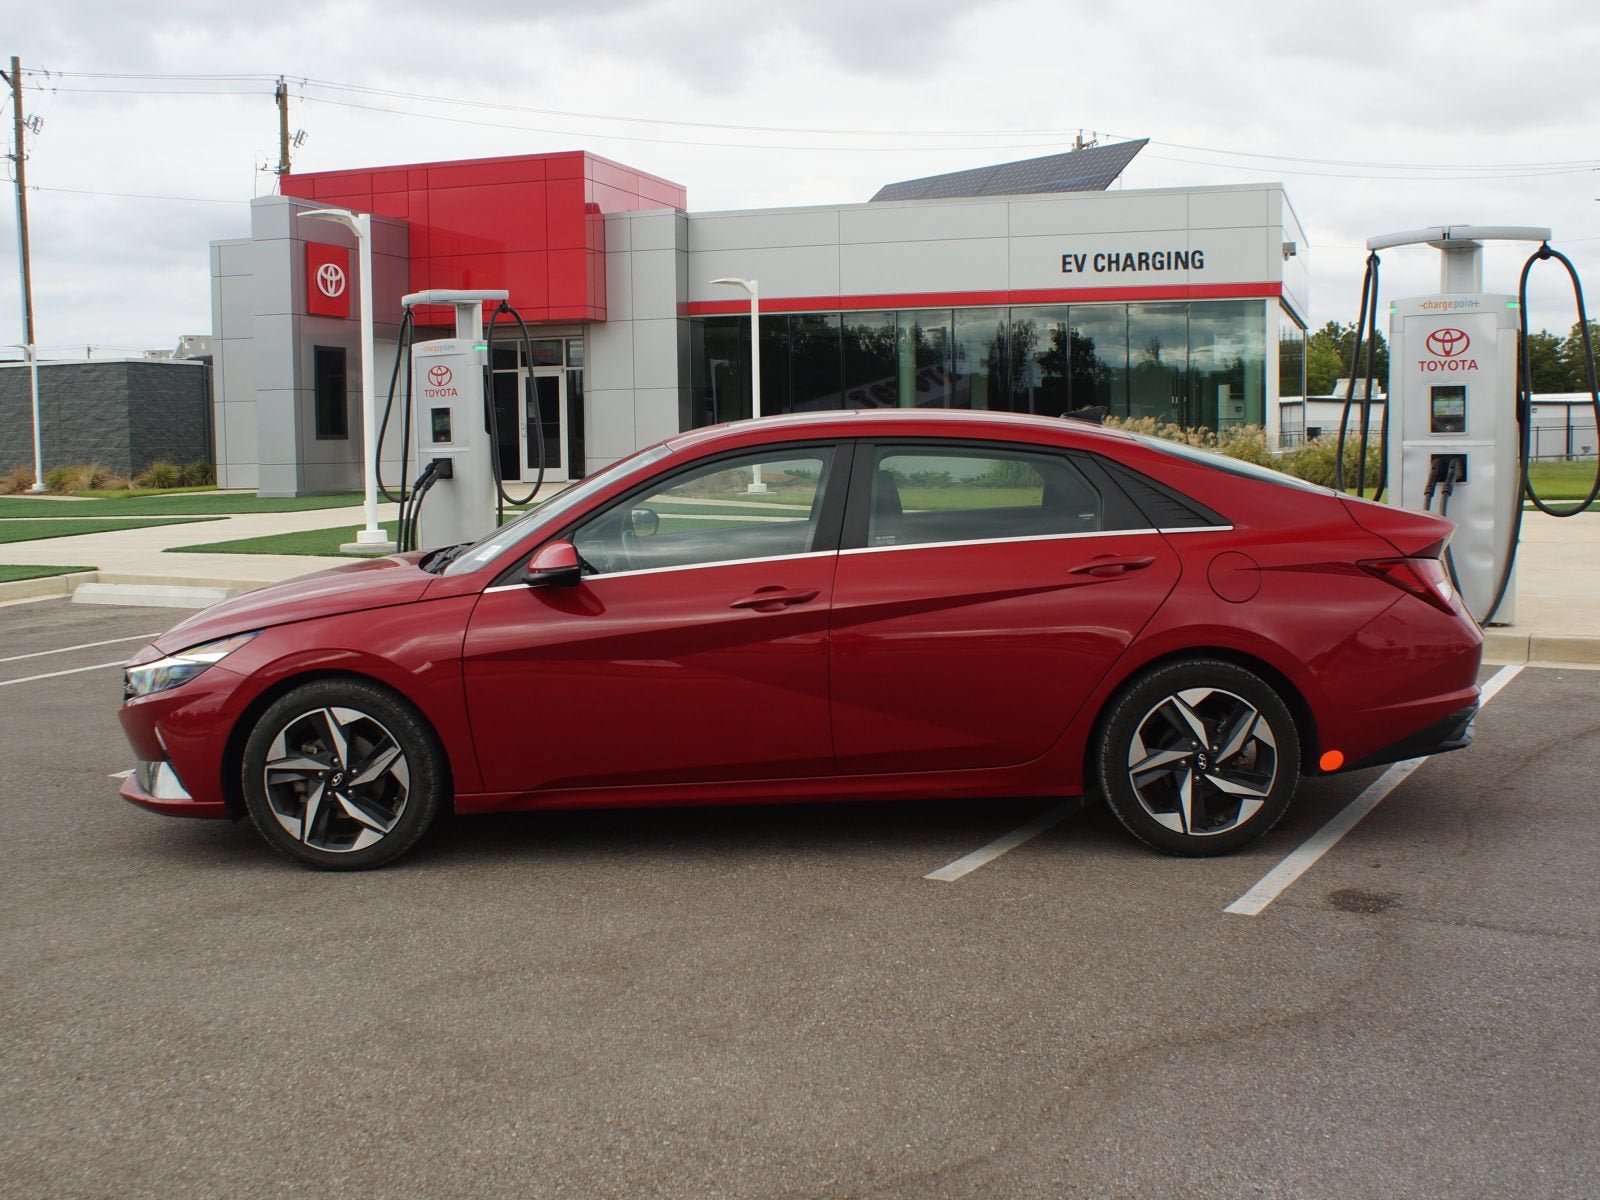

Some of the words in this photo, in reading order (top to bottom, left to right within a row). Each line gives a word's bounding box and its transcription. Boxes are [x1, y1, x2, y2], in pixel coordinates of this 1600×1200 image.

[1061, 253, 1087, 273] EV
[1093, 250, 1205, 273] CHARGING
[1418, 359, 1479, 372] TOYOTA
[424, 388, 458, 398] TOYOTA
